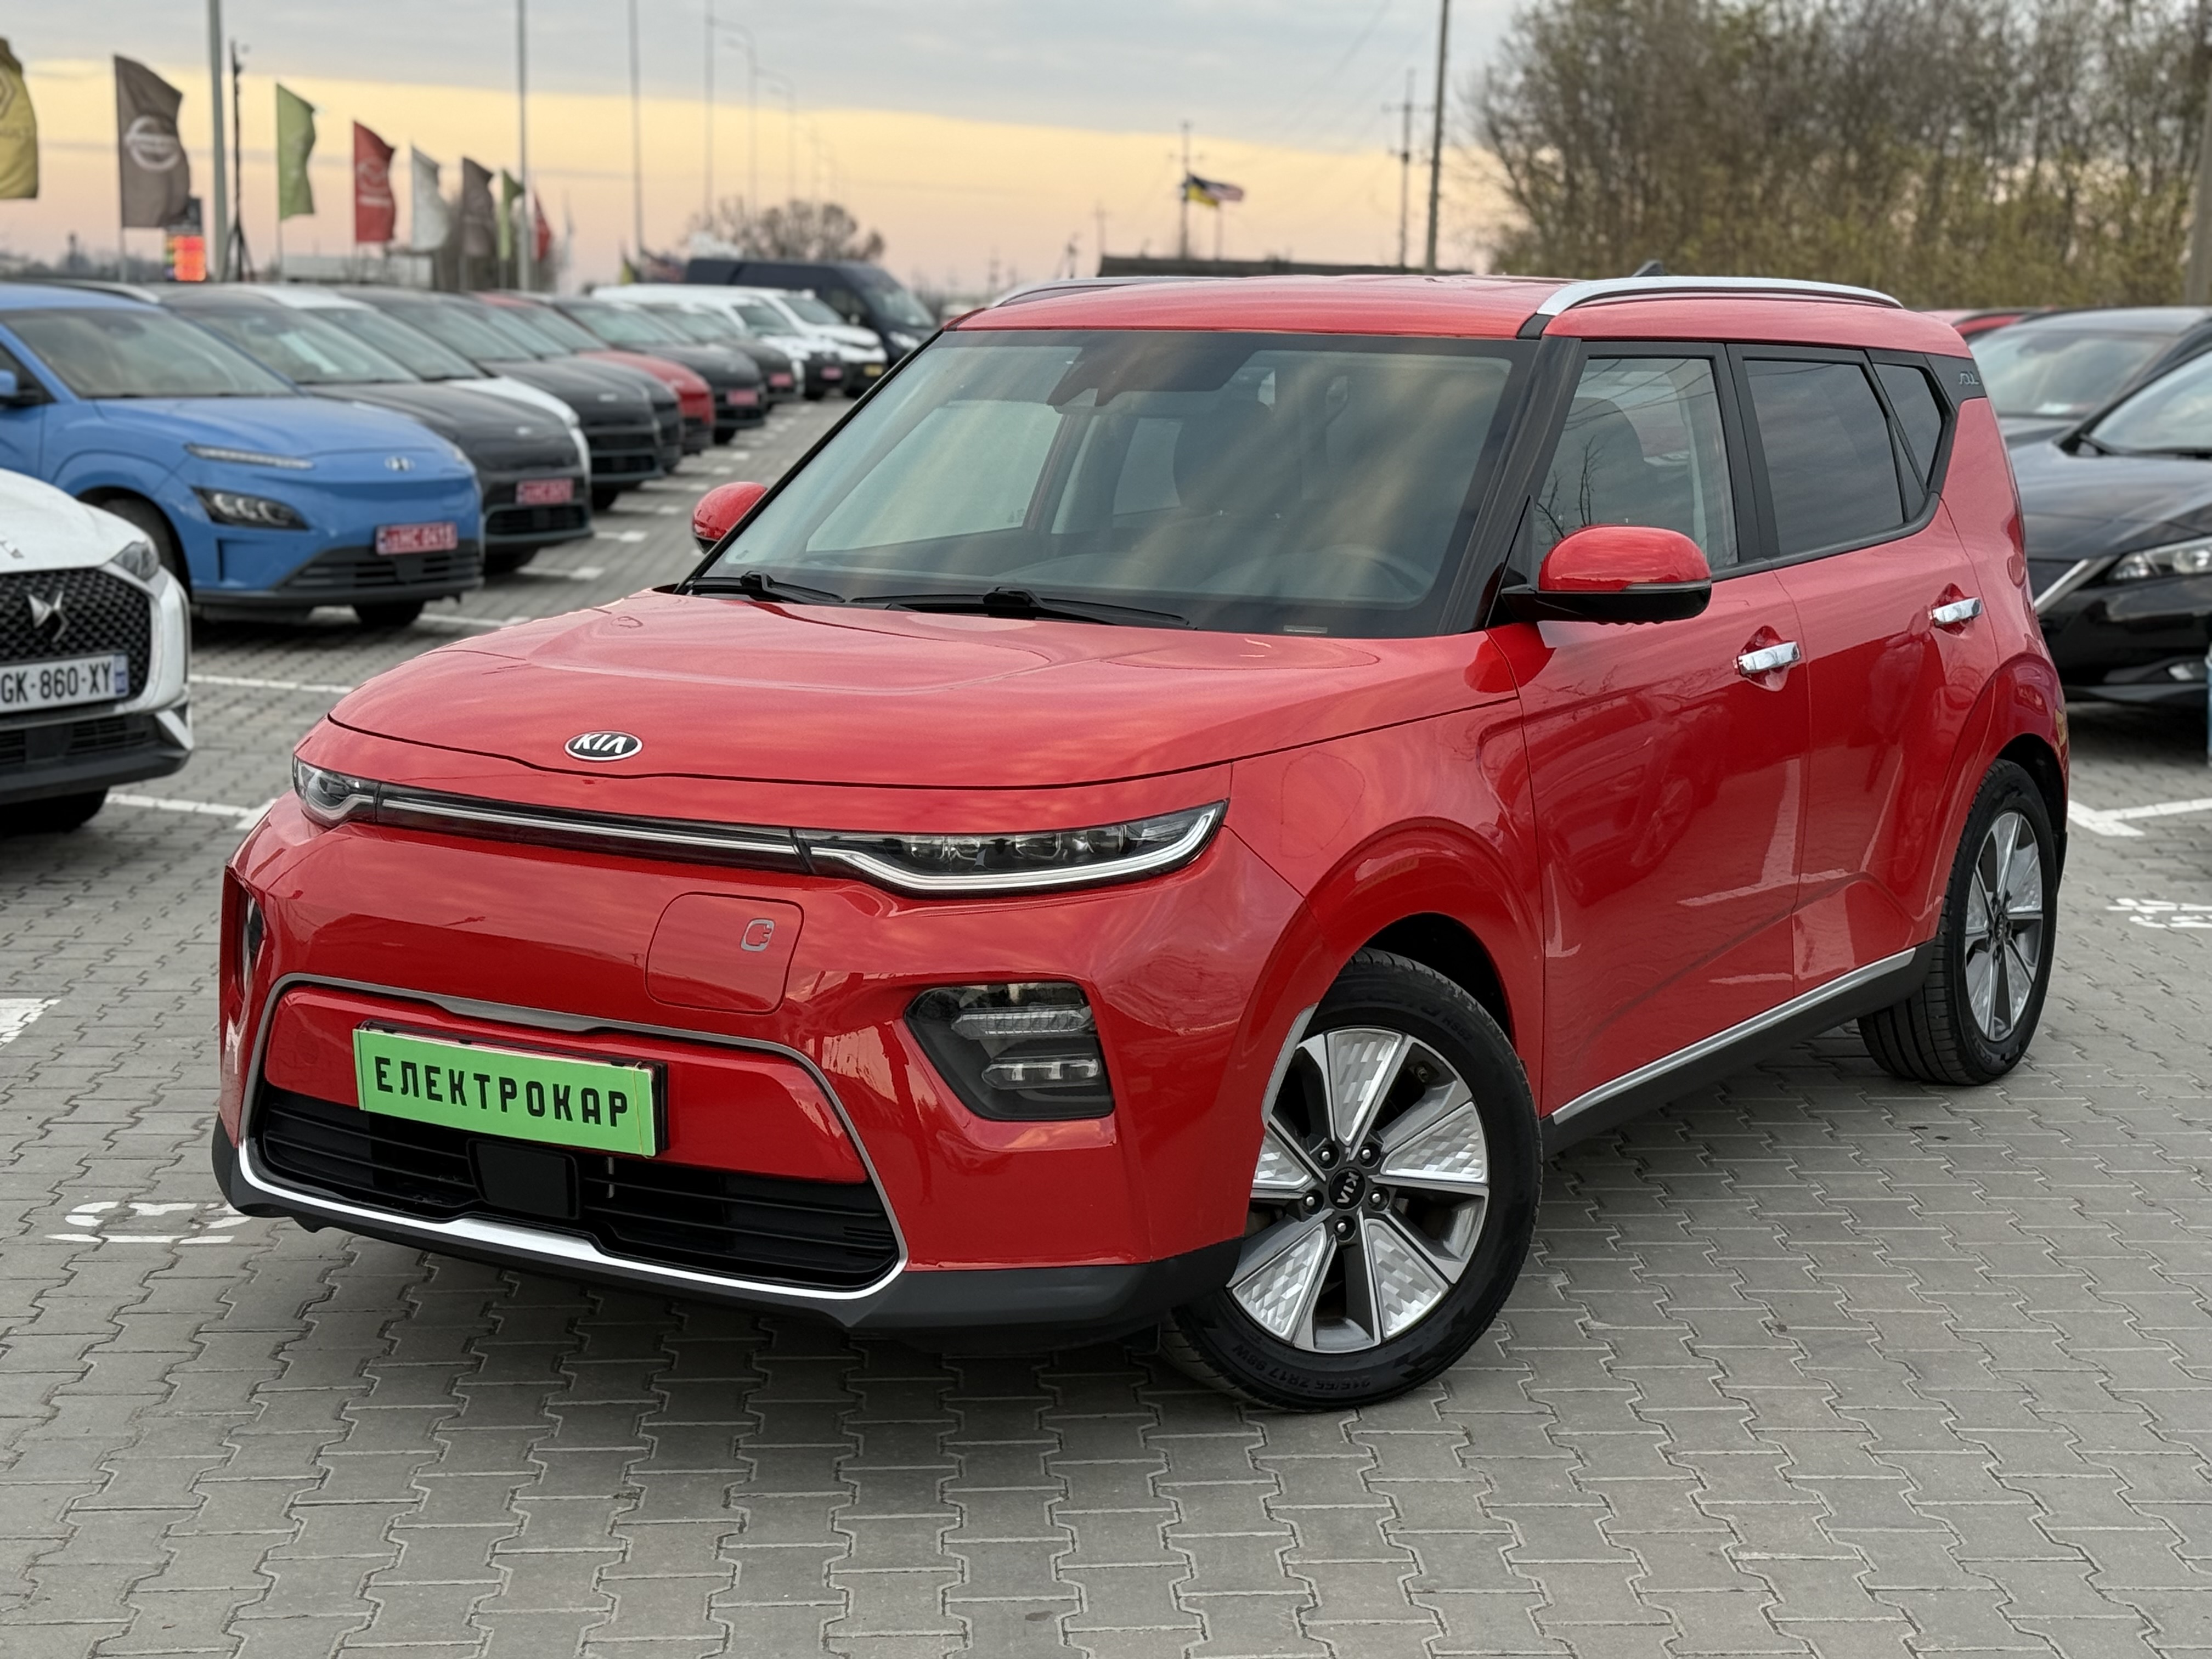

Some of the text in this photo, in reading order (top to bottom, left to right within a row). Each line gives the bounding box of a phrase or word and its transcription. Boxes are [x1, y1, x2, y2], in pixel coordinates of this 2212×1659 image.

[573, 733, 628, 754] KIA
[374, 1056, 628, 1128] ЕЛЕКТРОКАР
[1336, 1171, 1359, 1203] KIA
